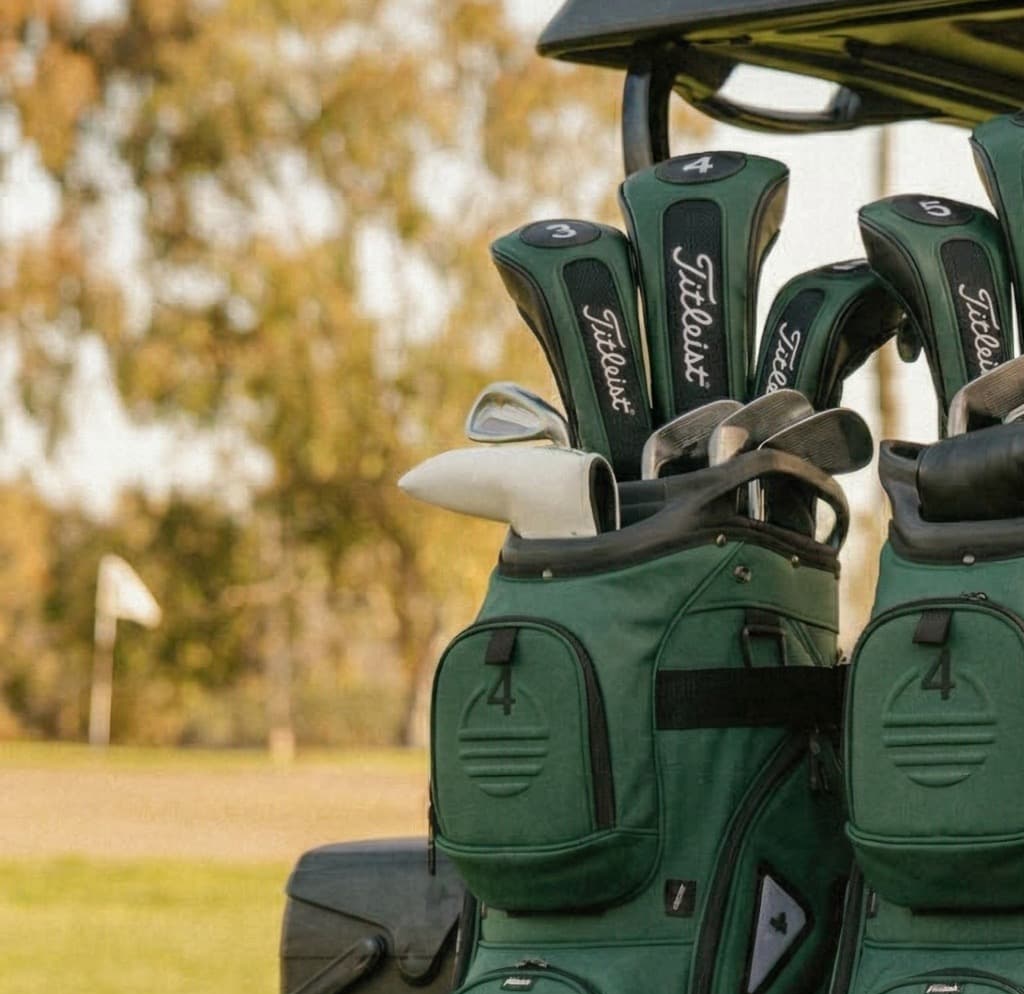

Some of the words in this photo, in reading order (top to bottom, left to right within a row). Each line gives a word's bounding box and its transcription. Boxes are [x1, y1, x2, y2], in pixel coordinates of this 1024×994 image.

[682, 156, 714, 174] 4
[546, 223, 577, 239] 3
[918, 200, 951, 217] 5
[672, 246, 717, 387] Titleist
[958, 283, 1000, 376] Titlei
[582, 304, 632, 414] Titleist
[766, 321, 801, 395] Title
[486, 665, 516, 716] 4
[921, 646, 956, 701] 4
